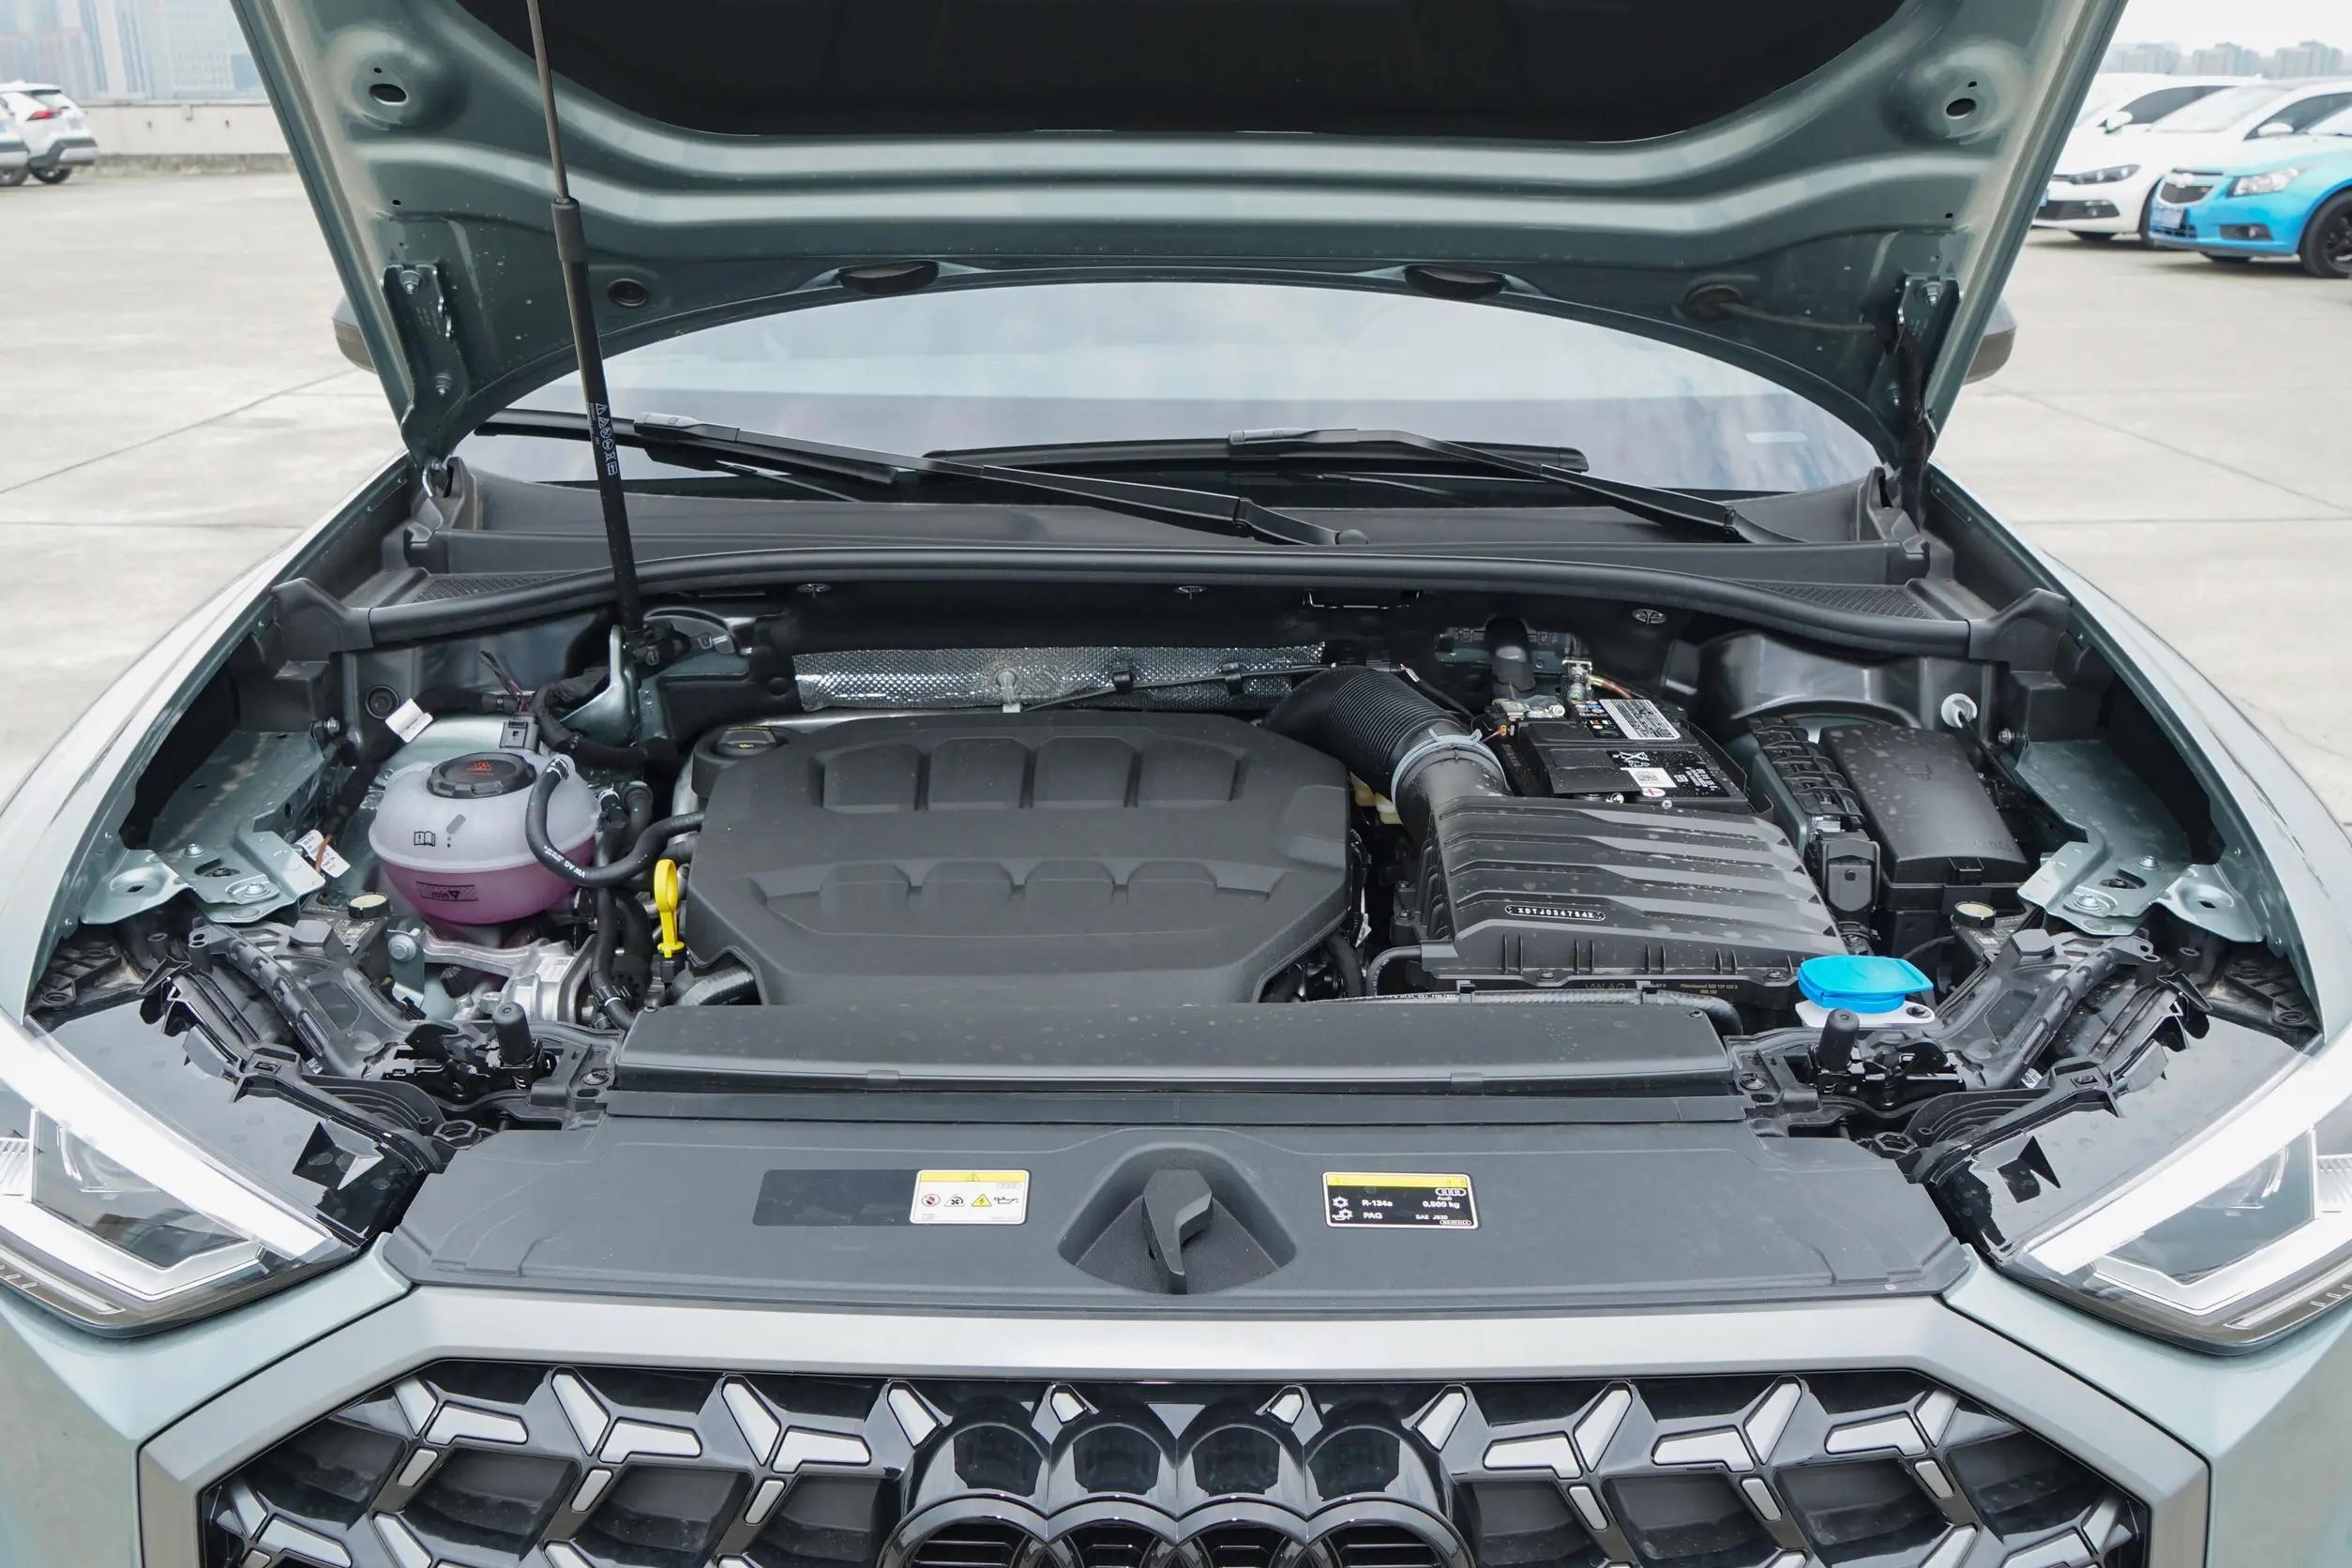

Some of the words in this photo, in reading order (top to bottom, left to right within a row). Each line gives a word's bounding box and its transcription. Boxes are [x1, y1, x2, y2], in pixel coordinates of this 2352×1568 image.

[564, 860, 576, 870] AG
[573, 867, 585, 878] VW
[430, 891, 449, 899] min
